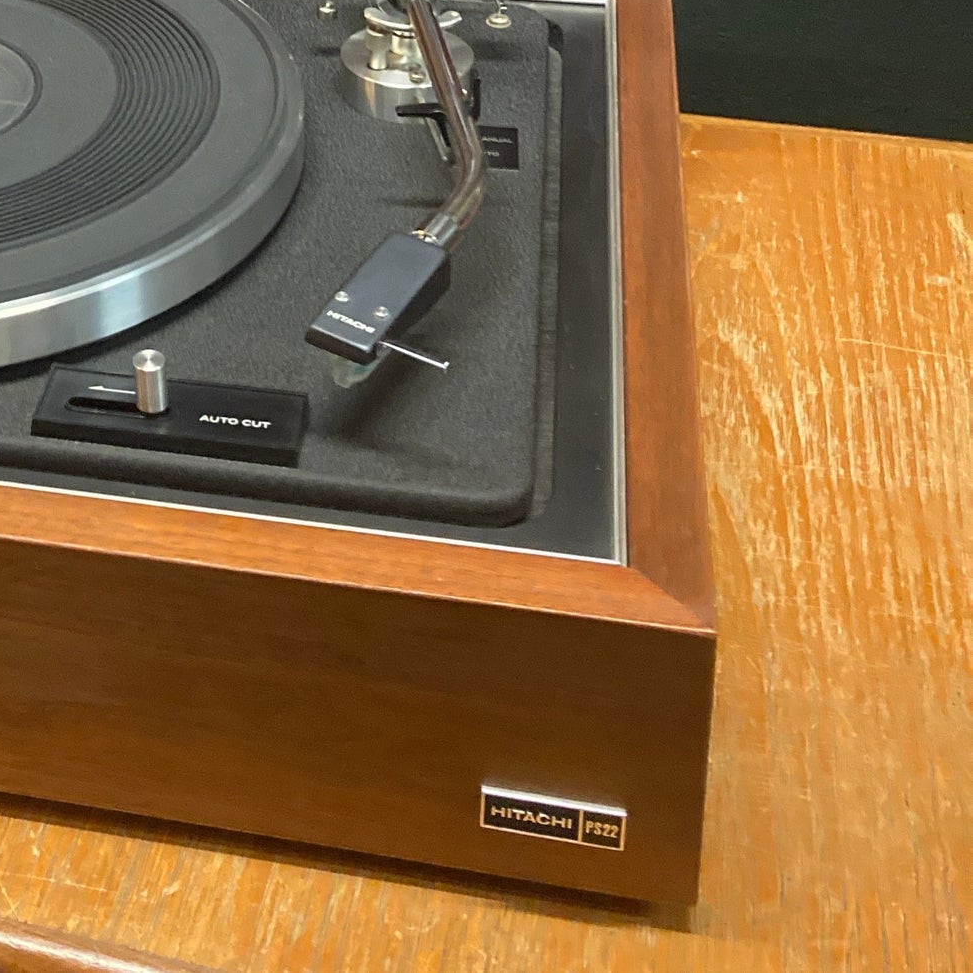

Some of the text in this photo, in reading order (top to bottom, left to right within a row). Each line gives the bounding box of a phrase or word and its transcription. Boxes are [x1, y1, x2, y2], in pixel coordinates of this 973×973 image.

[326, 310, 376, 334] HITACHI
[199, 414, 272, 429] AUTO CUT
[490, 805, 619, 839] HITACHI PS22
